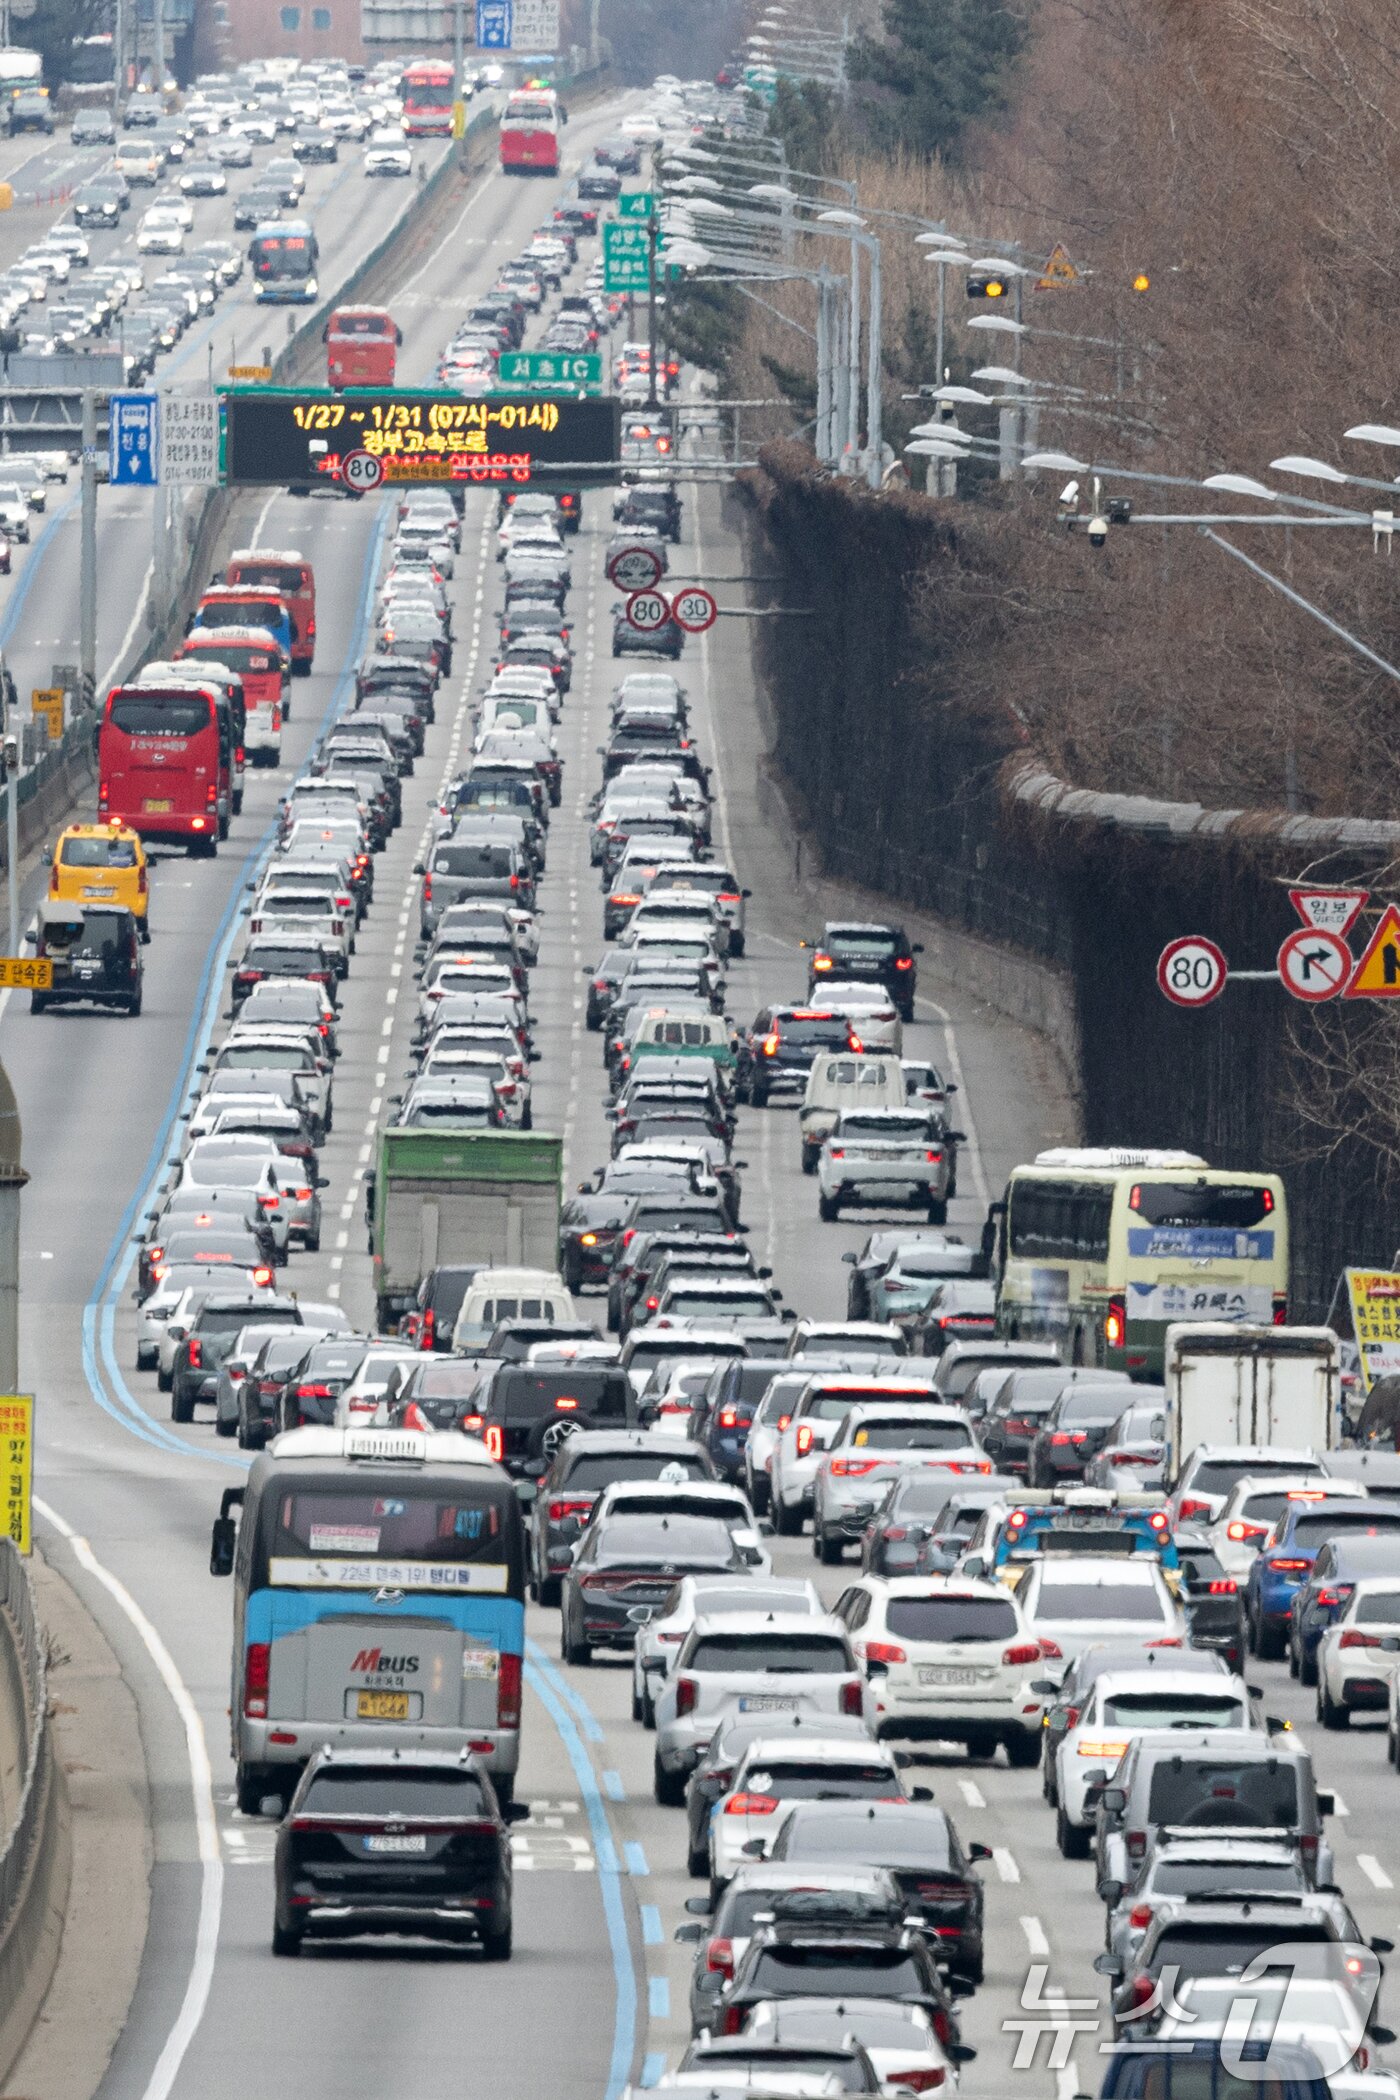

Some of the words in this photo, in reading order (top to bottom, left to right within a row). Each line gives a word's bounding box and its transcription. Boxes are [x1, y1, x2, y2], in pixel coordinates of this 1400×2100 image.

[561, 359, 589, 378] IC
[293, 404, 345, 430] 1/27
[371, 404, 421, 430] 1/31
[350, 459, 378, 478] 80
[634, 601, 660, 620] 80
[1311, 900, 1348, 914] 양보
[1172, 957, 1213, 988] 80
